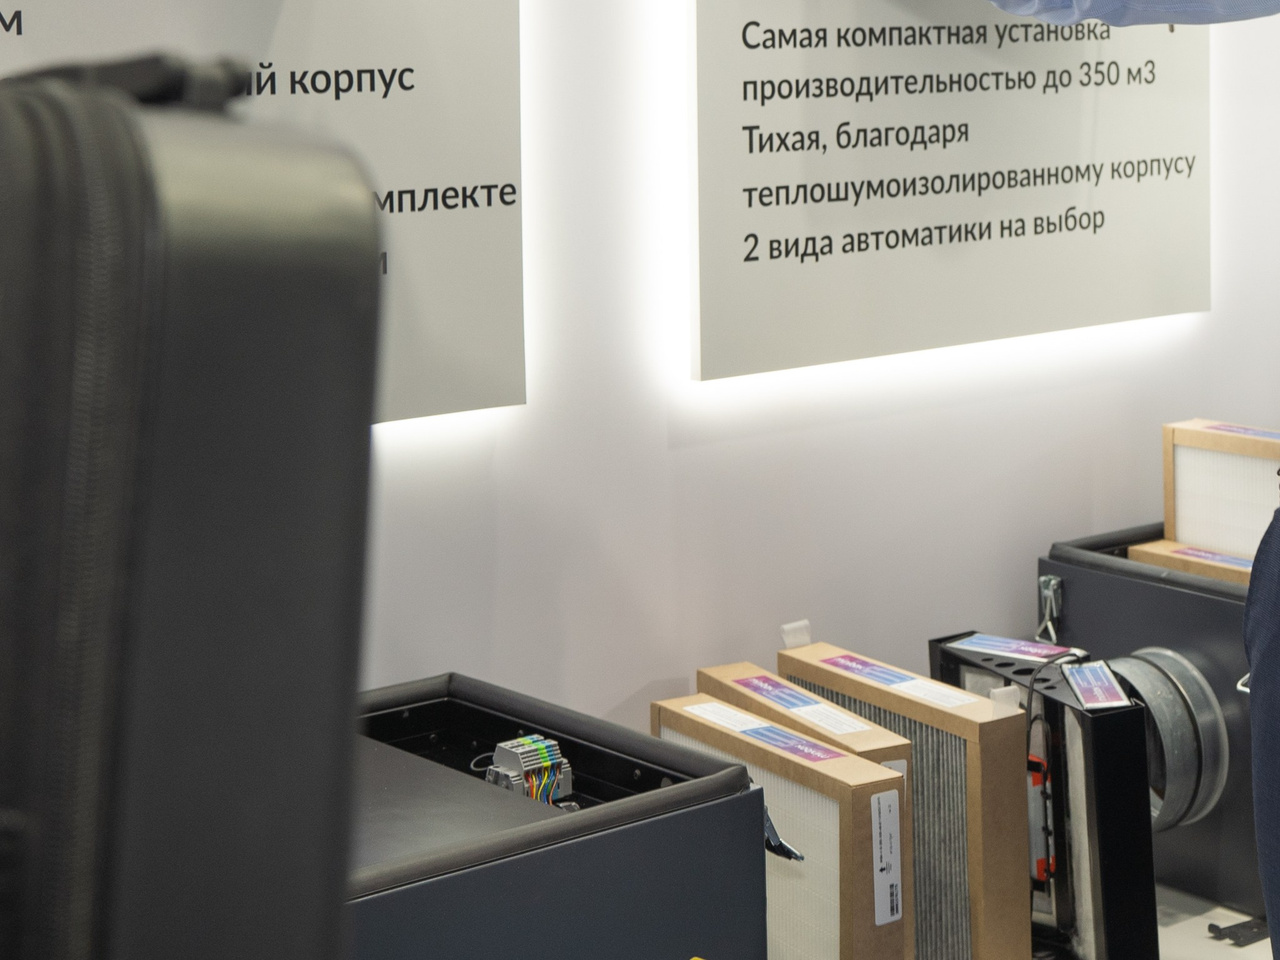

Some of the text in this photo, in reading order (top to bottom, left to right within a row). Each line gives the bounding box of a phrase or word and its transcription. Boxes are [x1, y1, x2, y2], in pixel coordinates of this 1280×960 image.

[742, 22, 1111, 50] Самая компактная установка
[290, 67, 415, 101] корпус
[743, 60, 1156, 107] производительностью до 350 м3
[742, 120, 969, 154] Тихая, благодаря
[743, 152, 1196, 208] теплошумоизолированному корпусу
[743, 206, 1105, 264] 2 вида автоматики на выбор
